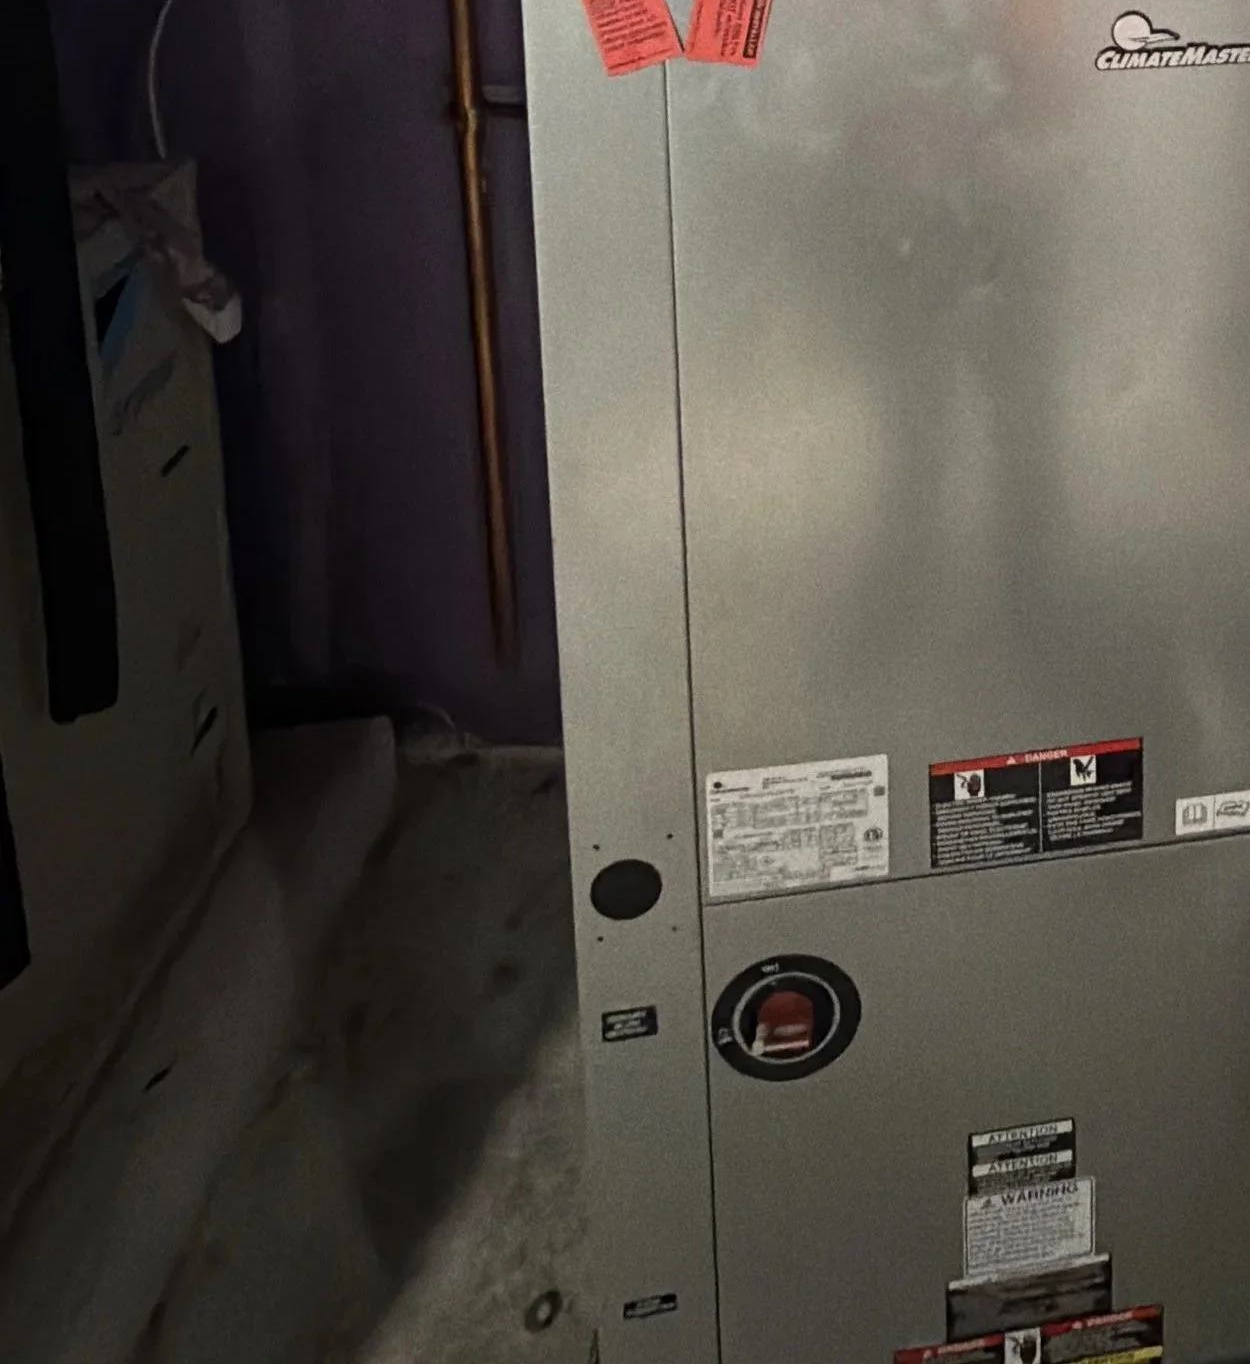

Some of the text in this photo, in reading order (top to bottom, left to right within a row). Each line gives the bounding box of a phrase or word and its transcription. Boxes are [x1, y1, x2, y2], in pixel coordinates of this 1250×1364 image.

[1024, 748, 1069, 764] DANGER
[988, 1123, 1059, 1144] ATTENTION
[988, 1153, 1059, 1173] ATTENTION
[1000, 1181, 1079, 1206] WARNING
